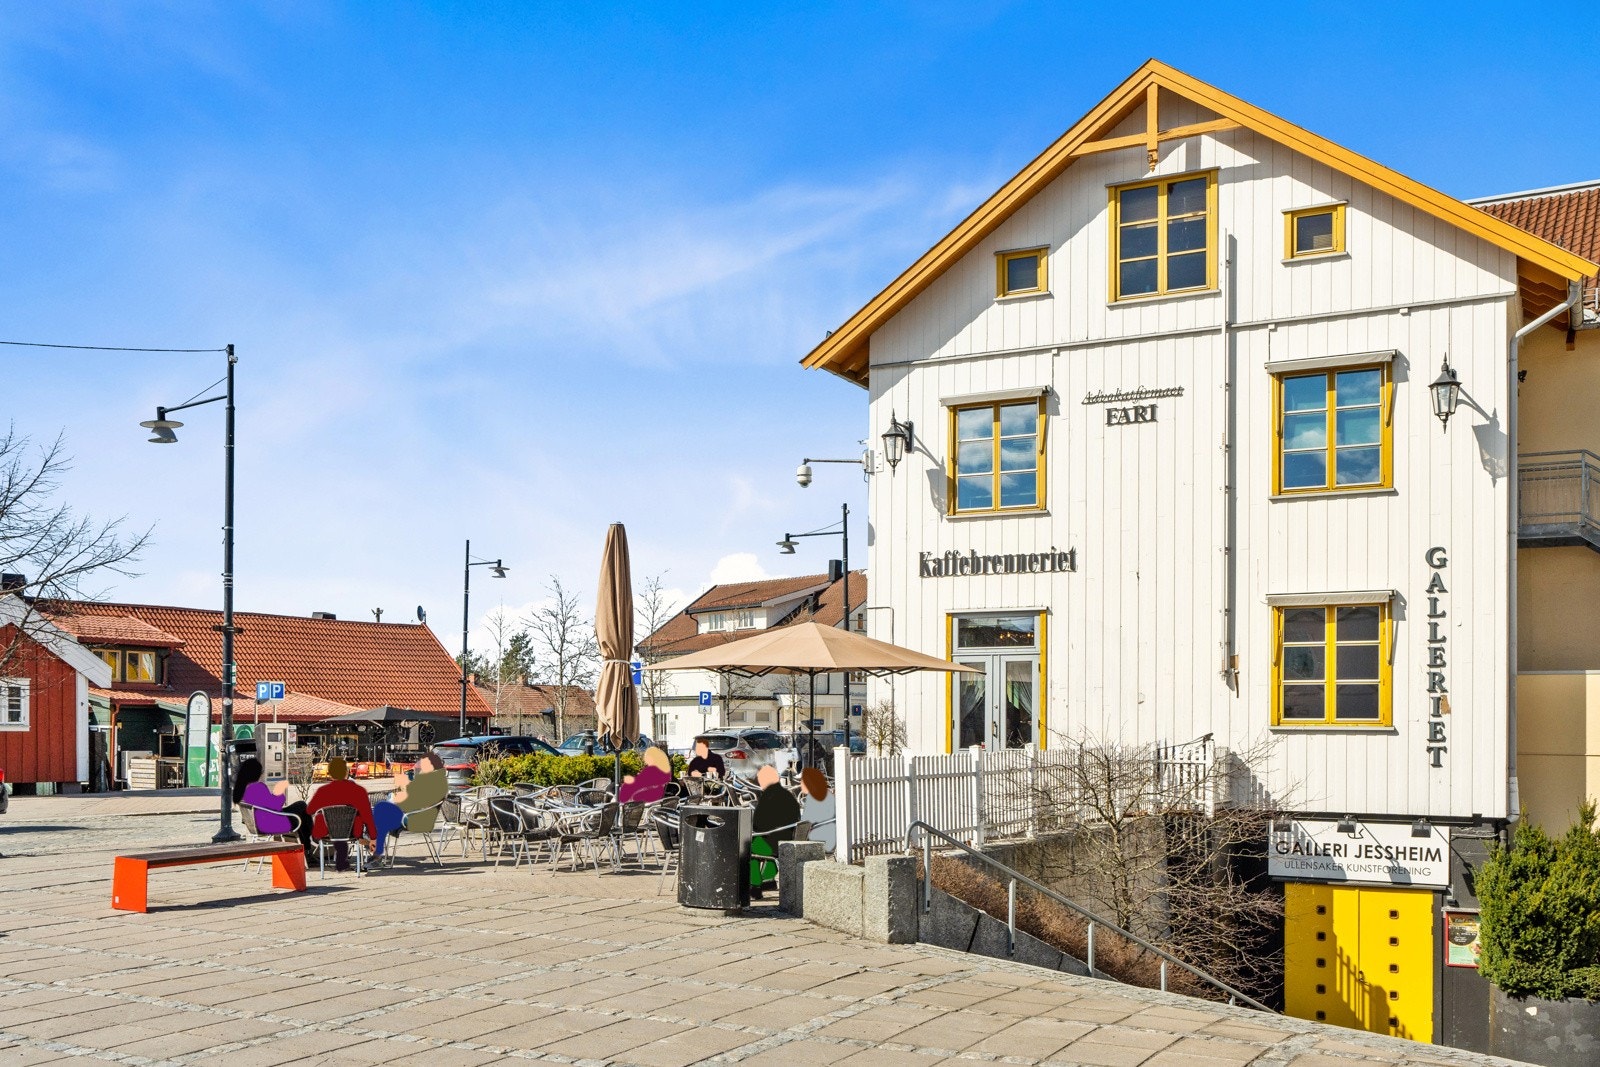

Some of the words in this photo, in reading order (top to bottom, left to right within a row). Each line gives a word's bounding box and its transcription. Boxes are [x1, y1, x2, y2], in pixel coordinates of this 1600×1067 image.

[1105, 404, 1158, 427] FARI
[919, 546, 1078, 577] Kaffebrenneriet
[1425, 547, 1448, 767] GALLERIET
[259, 684, 267, 698] P
[273, 684, 281, 698] P
[701, 692, 710, 704] P
[1275, 841, 1347, 858] GALLERI
[1355, 845, 1443, 862] JESSHEIM
[1284, 860, 1344, 872] ULLENSAKER
[1347, 864, 1431, 876] KUNSTFORENING
